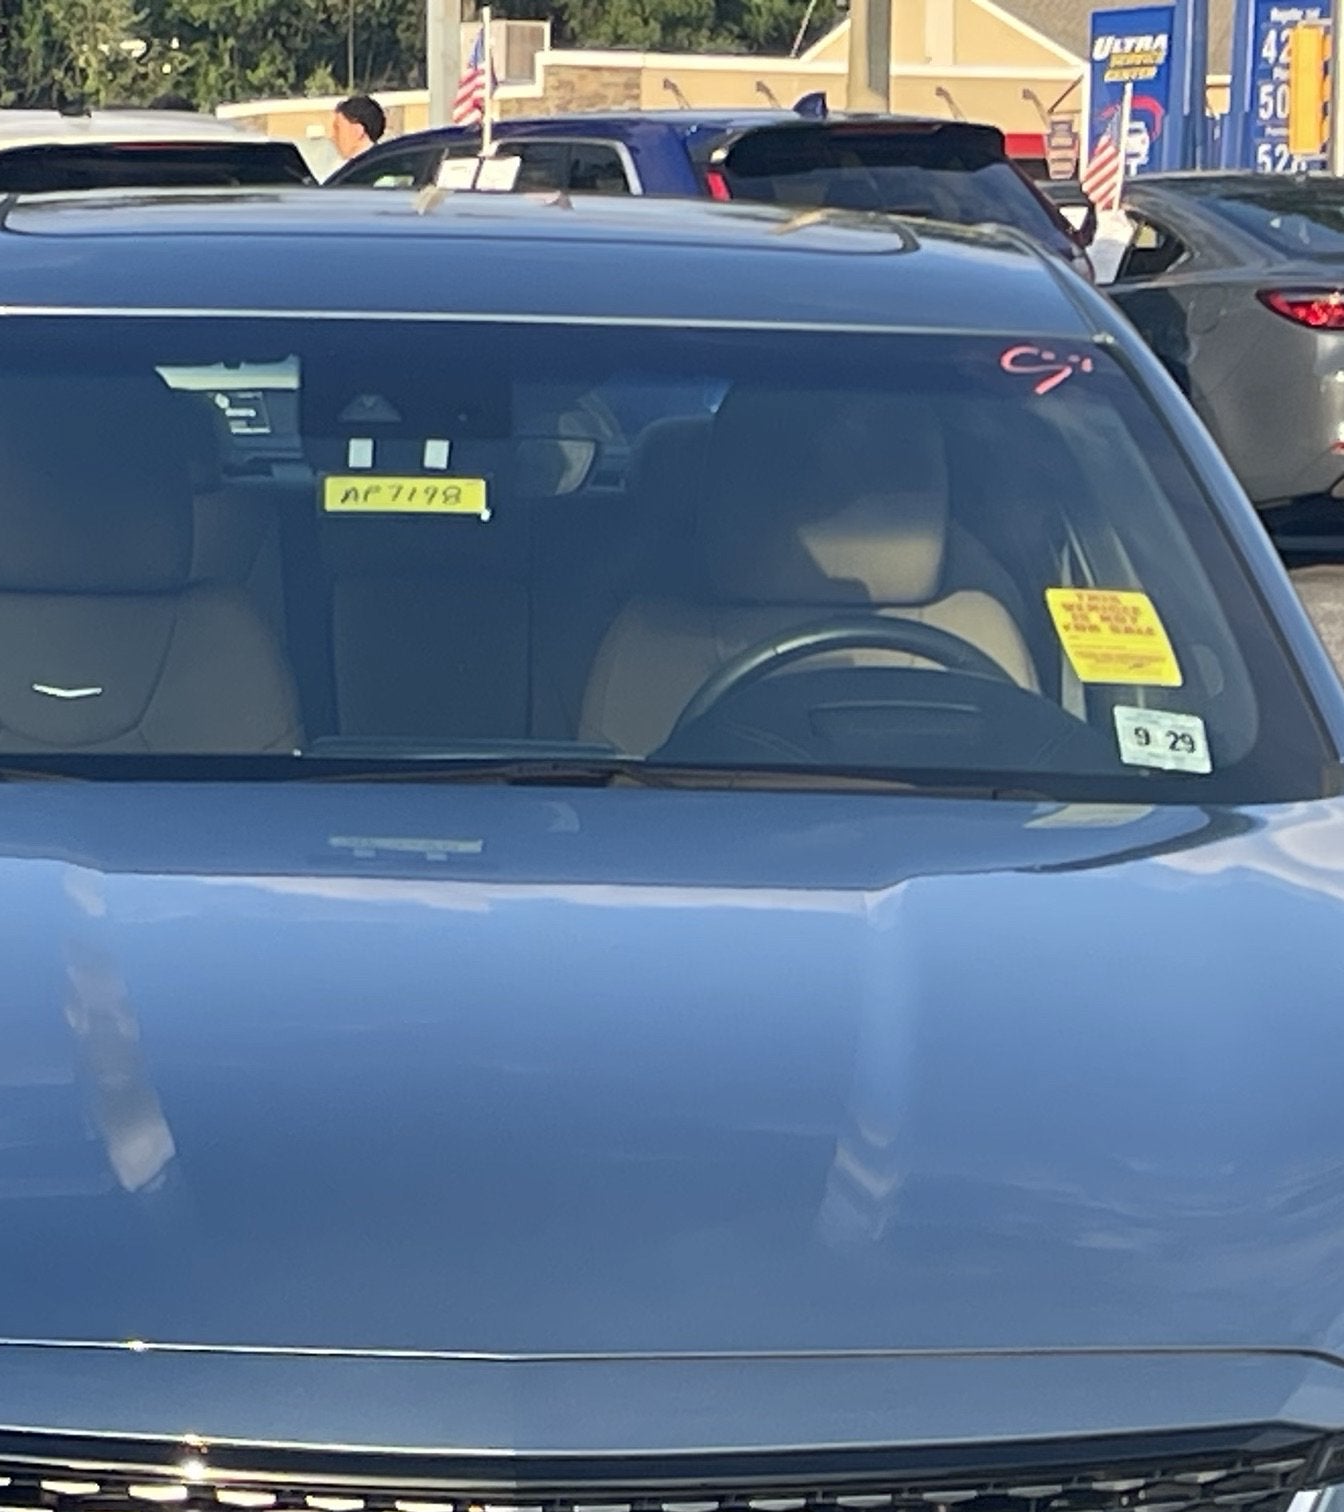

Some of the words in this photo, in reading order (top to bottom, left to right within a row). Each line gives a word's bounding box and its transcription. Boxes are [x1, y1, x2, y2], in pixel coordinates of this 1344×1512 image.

[1092, 34, 1168, 61] ULTRA
[1134, 727, 1151, 747] 9
[1166, 730, 1196, 754] 29
